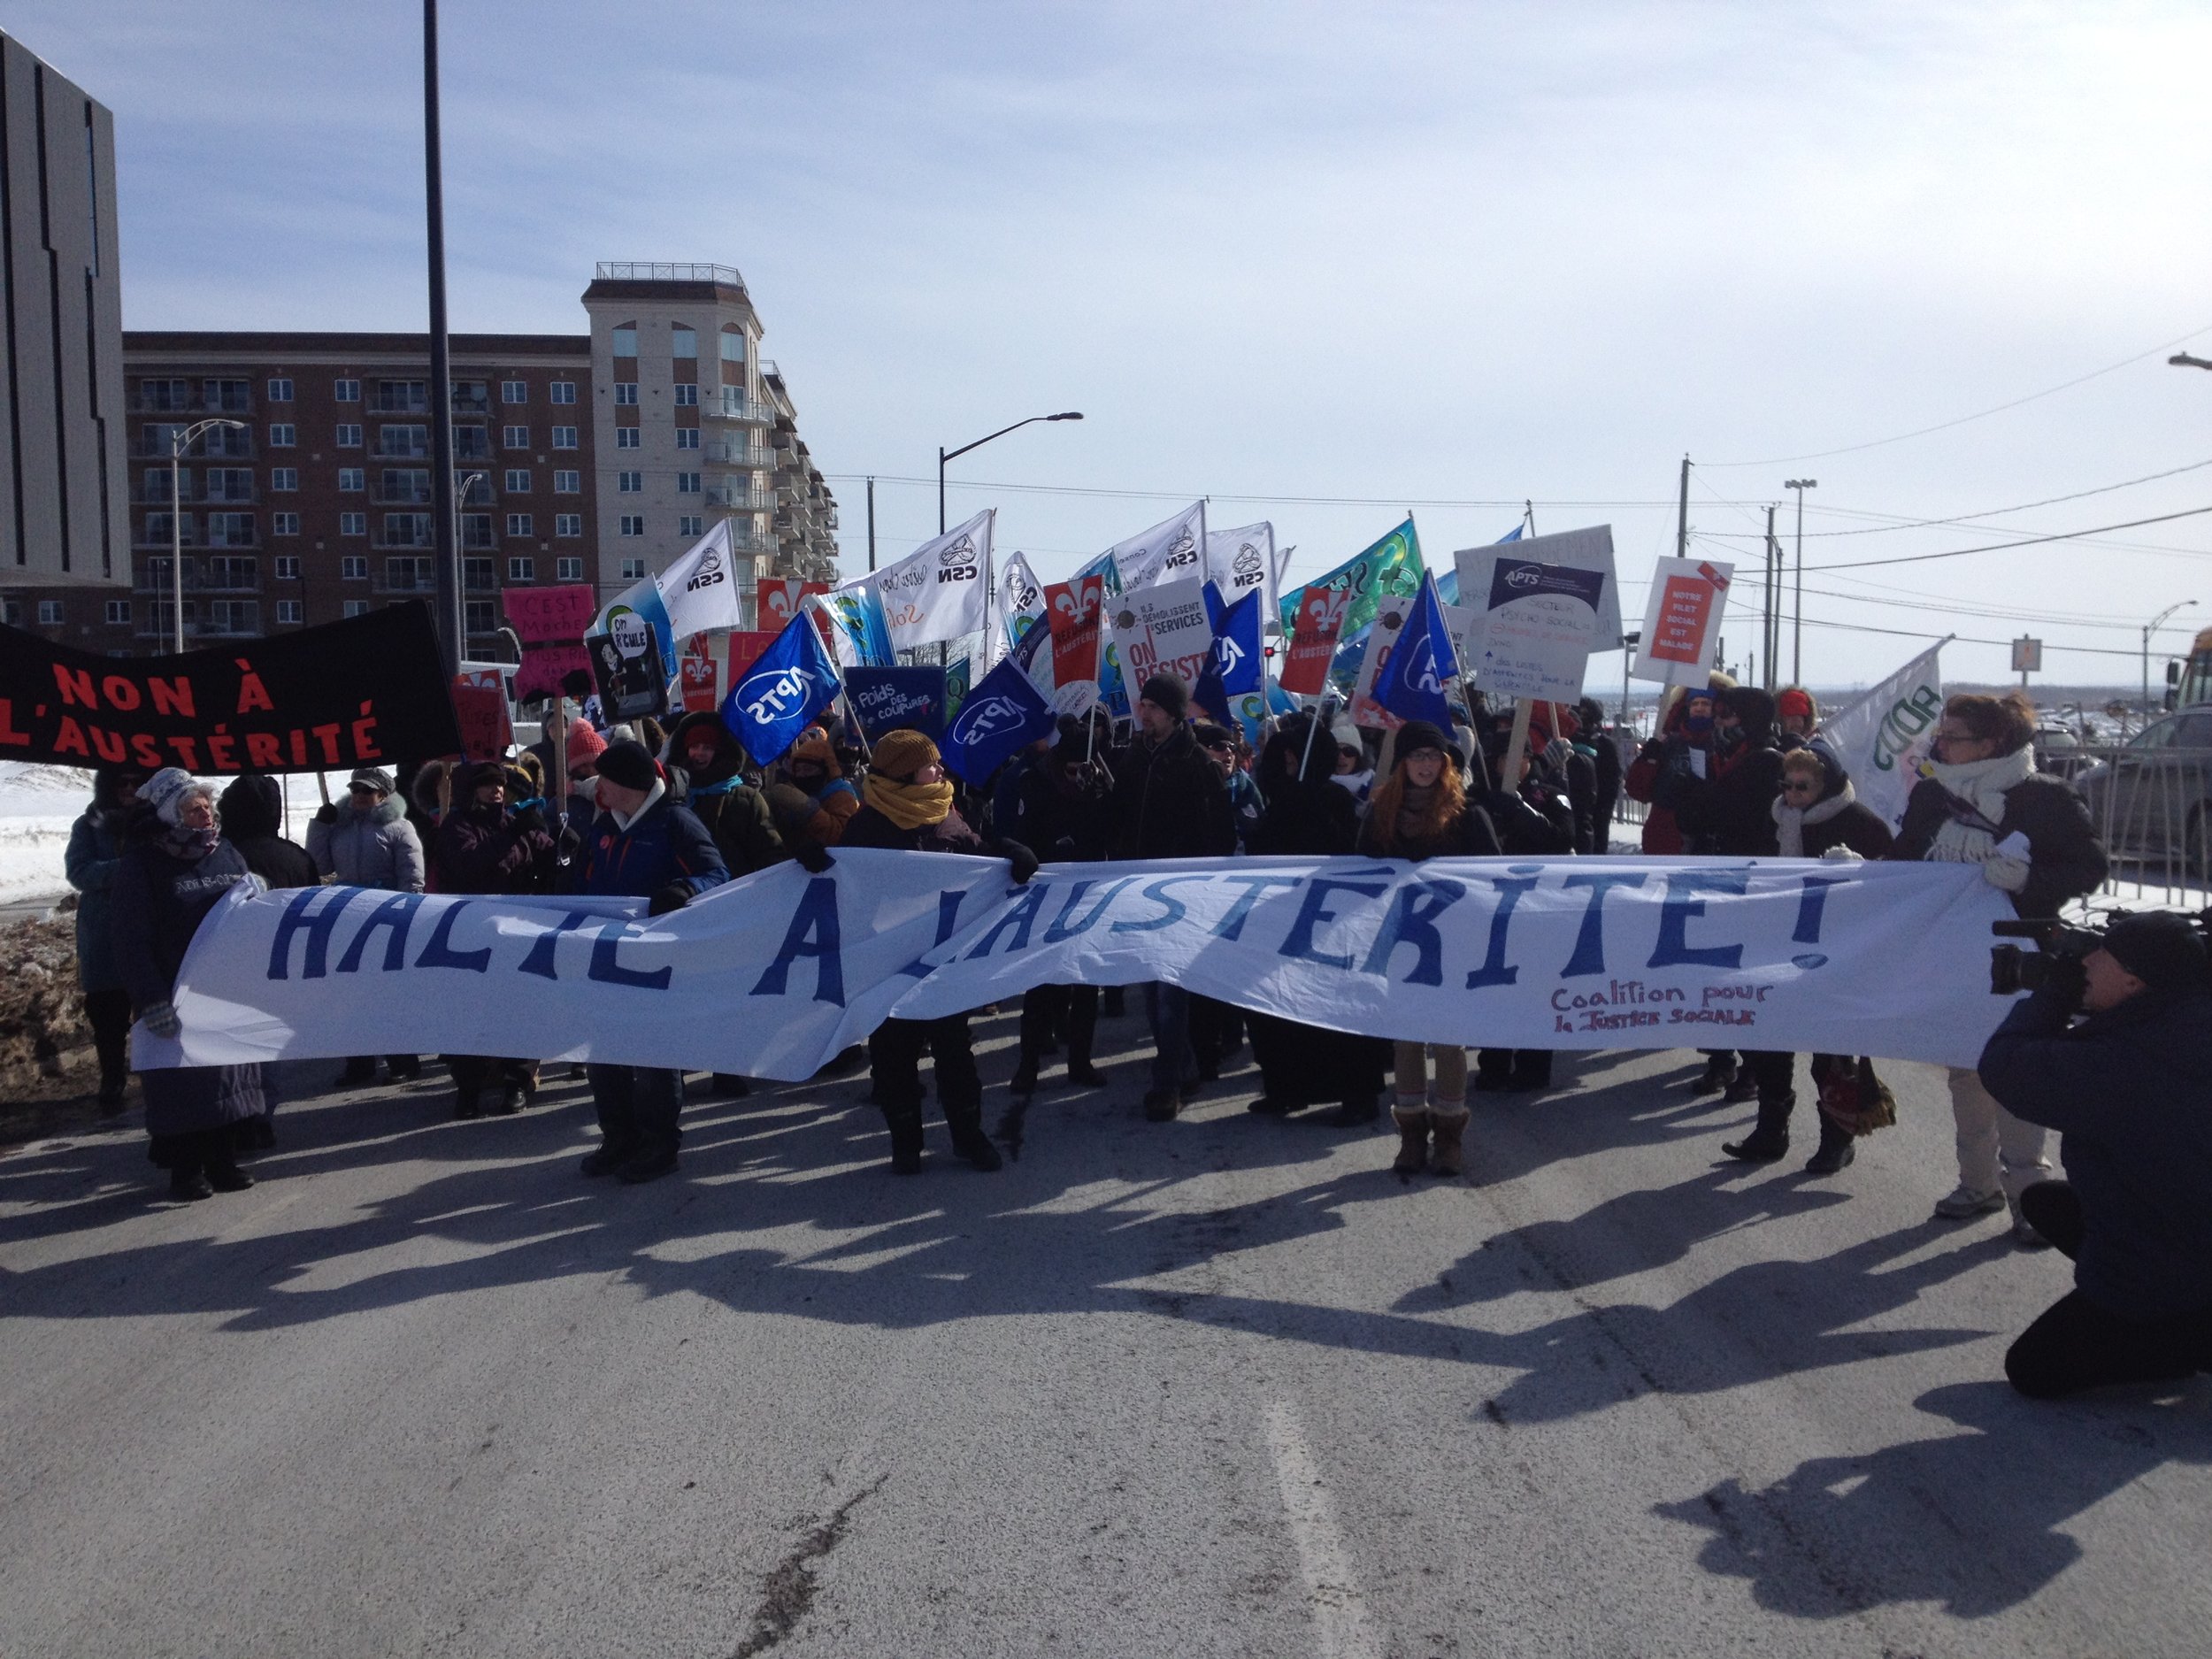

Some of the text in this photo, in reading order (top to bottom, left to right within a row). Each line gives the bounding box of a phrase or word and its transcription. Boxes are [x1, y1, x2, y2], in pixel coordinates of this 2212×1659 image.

[1505, 571, 1540, 586] APTS
[1155, 612, 1203, 634] SERVICES
[569, 647, 588, 660] RIE
[52, 658, 274, 718] NON À
[0, 699, 381, 770] L'AUSTÉRITÉ
[266, 887, 672, 990] HALTE
[1701, 985, 1774, 1007] pour
